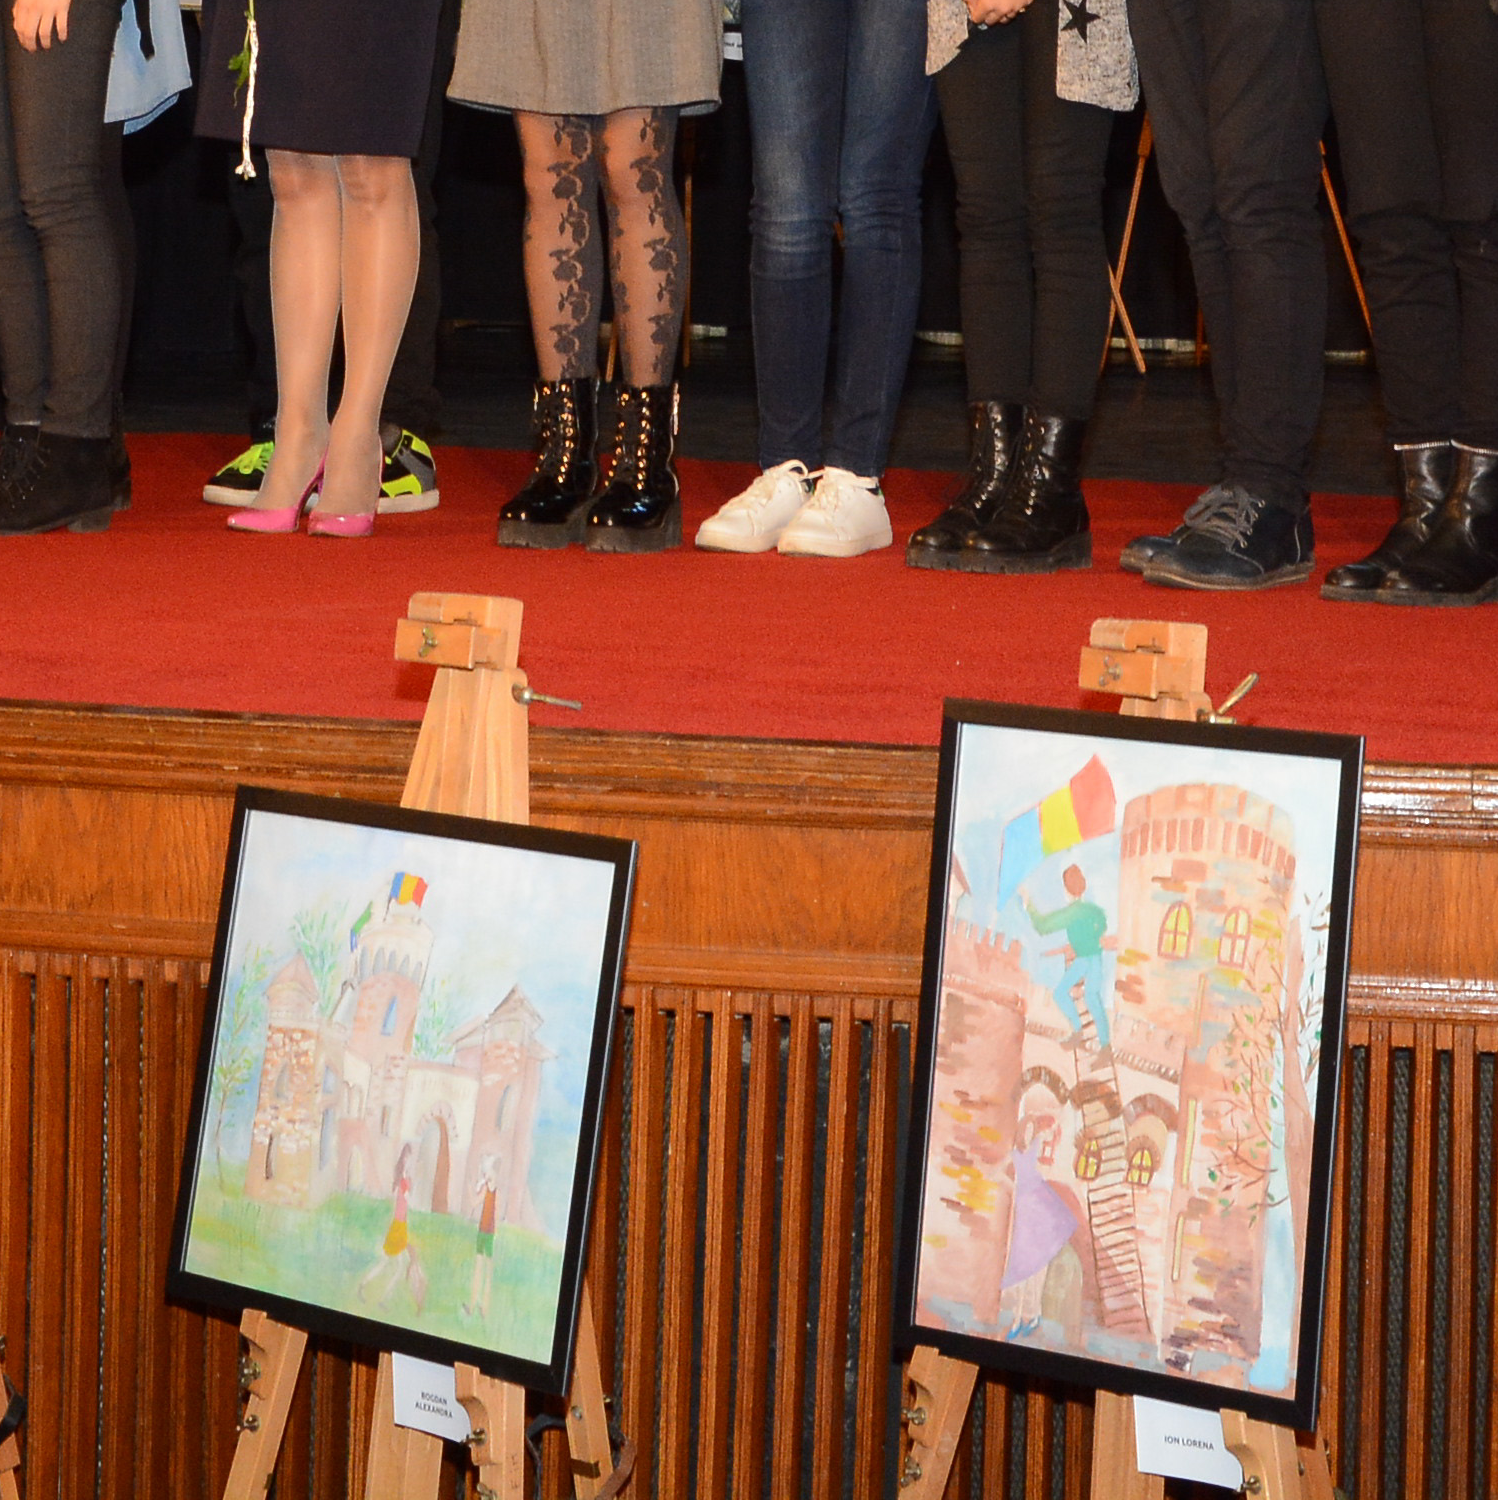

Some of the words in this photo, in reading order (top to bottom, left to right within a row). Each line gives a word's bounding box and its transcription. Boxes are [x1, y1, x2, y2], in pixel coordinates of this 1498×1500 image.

[421, 1391, 448, 1405] BOGDAN
[415, 1401, 453, 1419] ALEXANDRA
[1164, 1435, 1180, 1445] ION
[1182, 1437, 1214, 1451] LORENA
